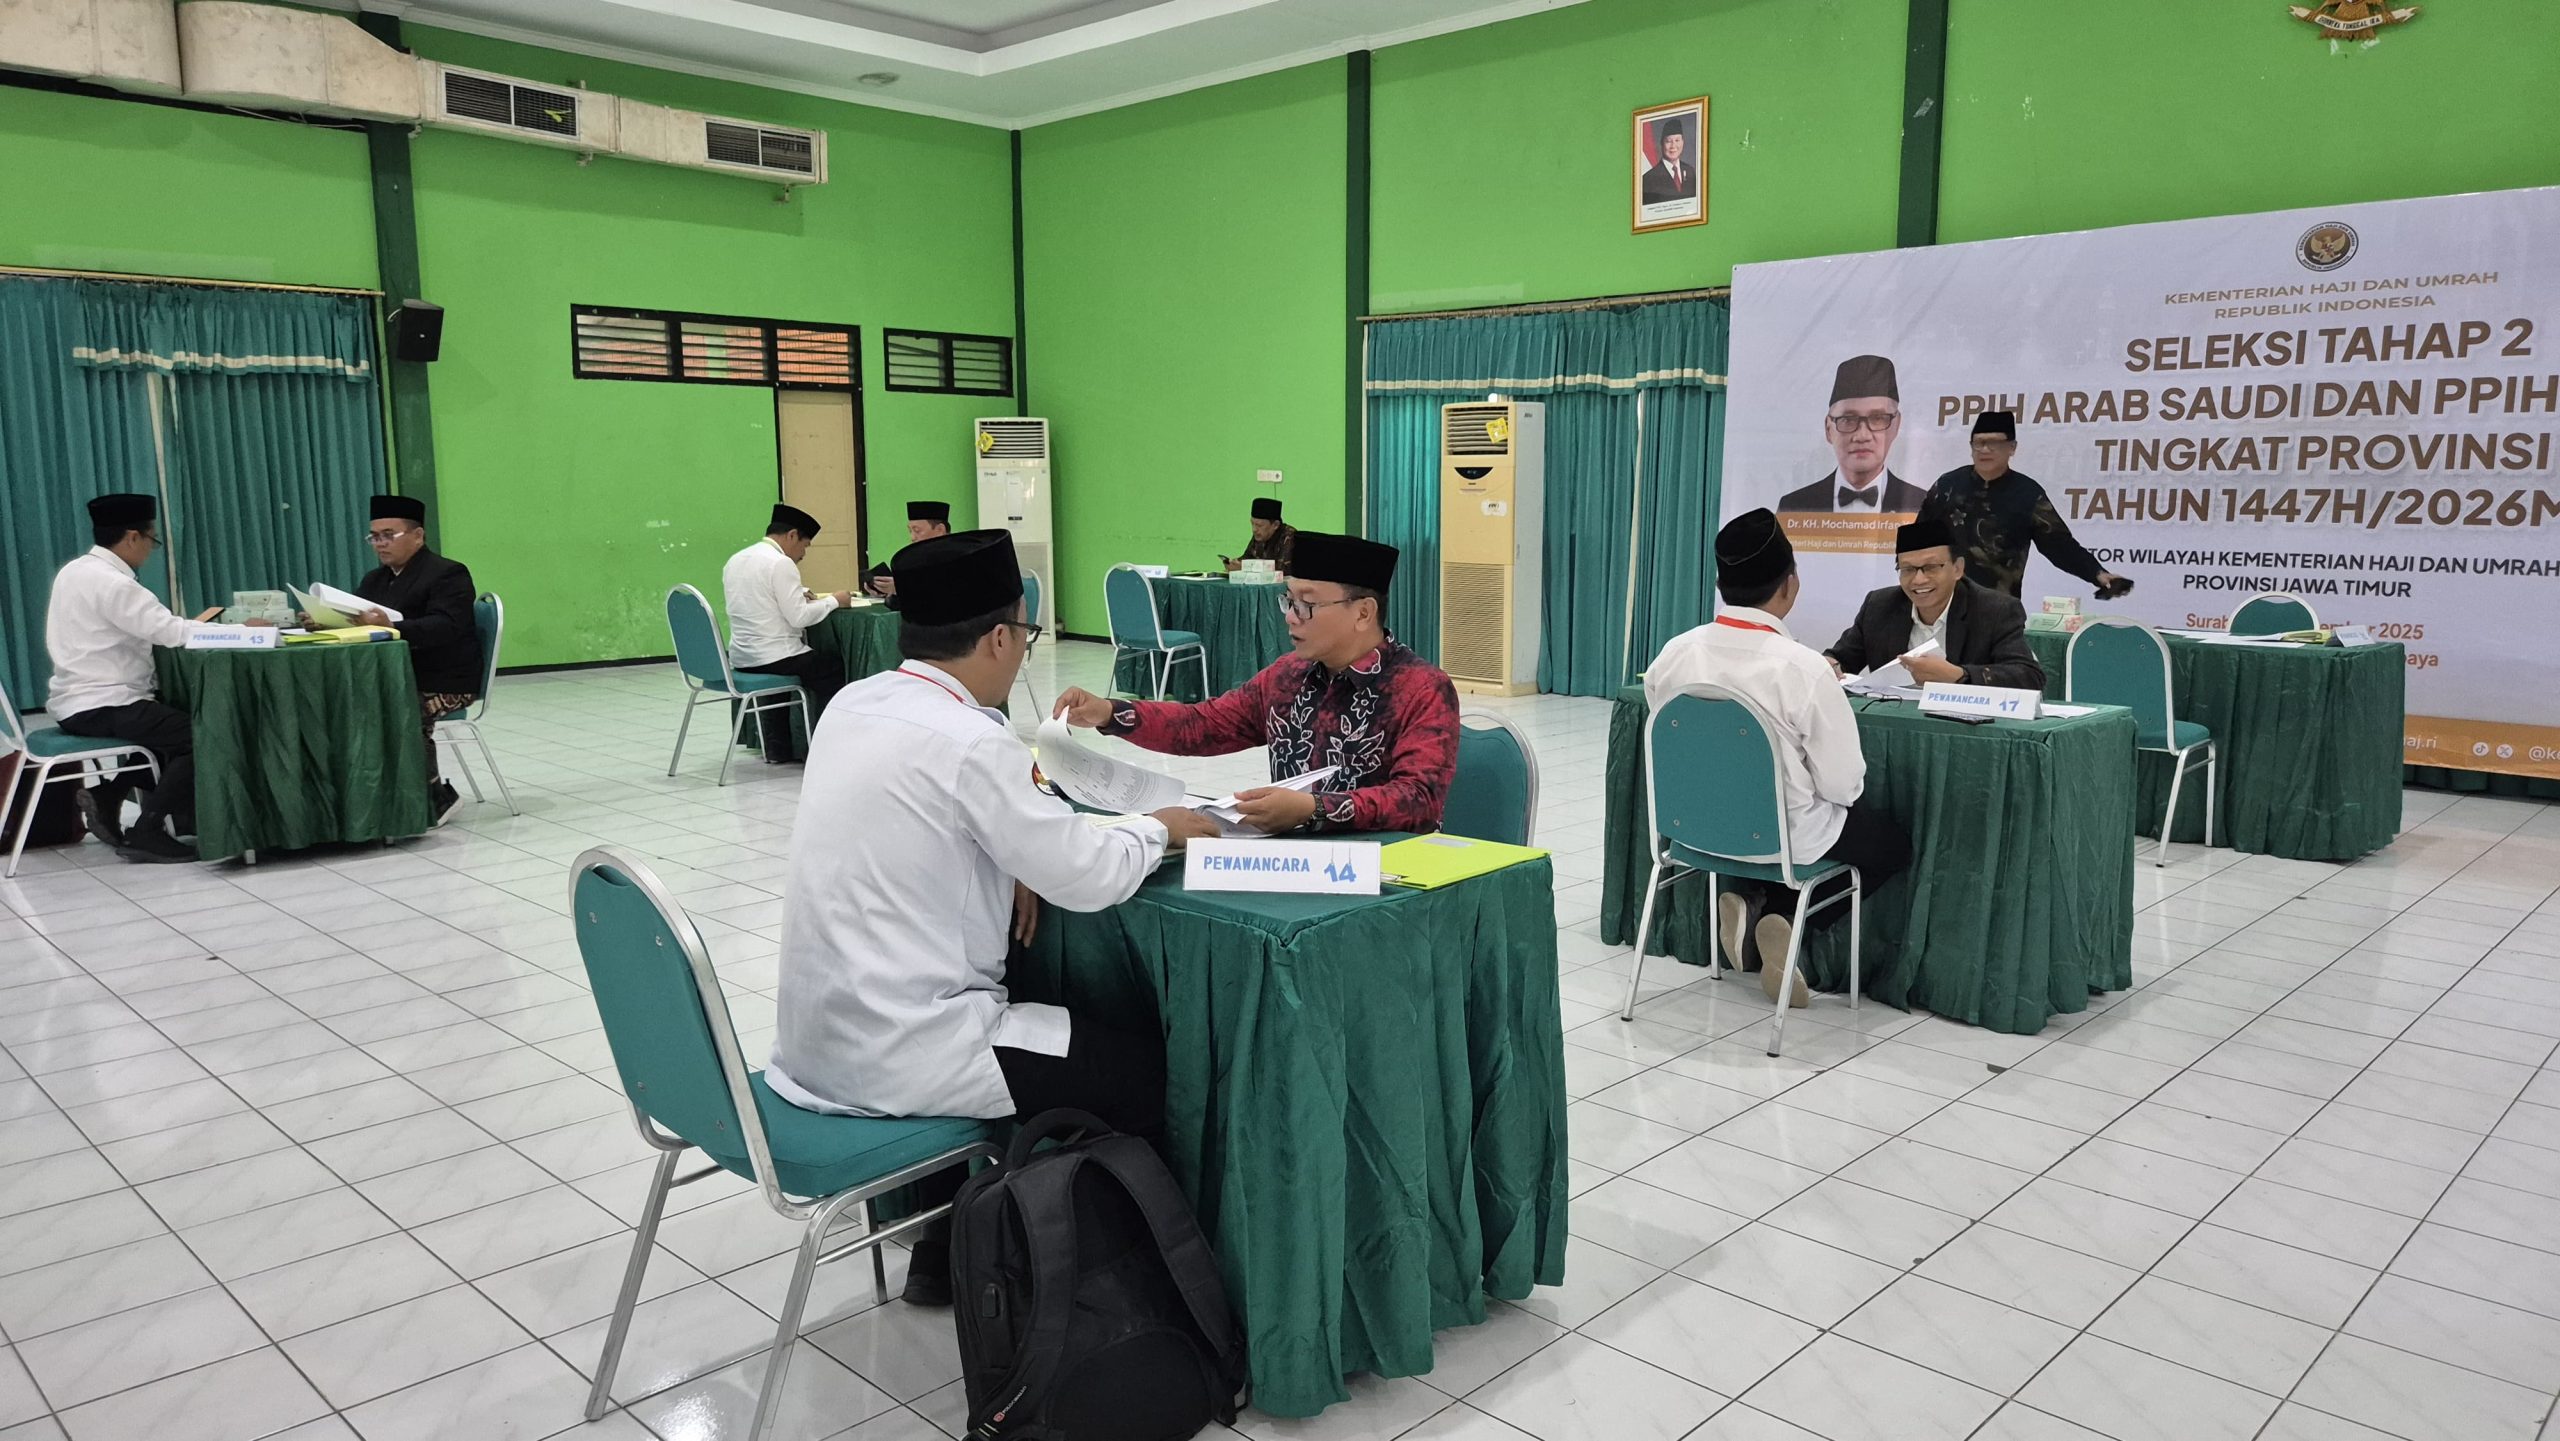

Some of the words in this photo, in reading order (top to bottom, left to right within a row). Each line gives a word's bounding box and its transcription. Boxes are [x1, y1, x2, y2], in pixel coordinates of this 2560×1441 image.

[2165, 284, 2304, 305] KEMENTERIAN
[2310, 281, 2356, 296] HAJI
[2363, 277, 2409, 292] DAN
[2416, 271, 2499, 288] UMRAH
[2214, 302, 2312, 320] REPUBLIK
[2318, 295, 2436, 313] INDONESIA
[2125, 330, 2307, 373] SELEKSI
[2318, 321, 2491, 364] TAHAP
[2501, 318, 2533, 356] 2
[1937, 393, 2025, 427] PPIH
[2032, 389, 2149, 424] ARAB
[2158, 383, 2302, 421] SAUDI
[2313, 379, 2422, 418] DAN
[2433, 375, 2560, 414] PPIH
[2094, 436, 2289, 471] TINGKAT
[2297, 432, 2551, 471] PROVINSI
[2064, 488, 2211, 521] TAHUN
[2221, 488, 2560, 529] 1447H/2026M
[1787, 519, 1800, 528] Dr.
[1803, 519, 1819, 528] KH.
[1822, 519, 1876, 530] Mochamad
[2086, 548, 2124, 563] TOR
[2129, 549, 2214, 566] WILAYAH
[2218, 552, 2365, 570] KEMENTERIAN
[2368, 555, 2414, 572] HAJI
[2419, 557, 2467, 574] DAN
[2472, 558, 2560, 577] UMRAH
[2183, 575, 2277, 592] PROVINSI
[2280, 578, 2338, 595] JAWA
[2343, 580, 2412, 598] TIMUR
[249, 635, 264, 644] 13
[2378, 622, 2425, 640] 2025
[2404, 653, 2439, 670] aya
[1928, 692, 1990, 706] PEWAWANCARA
[1998, 701, 2020, 712] 17
[1203, 855, 1311, 873] PEWAWANCARA
[1323, 862, 1357, 883] 14
